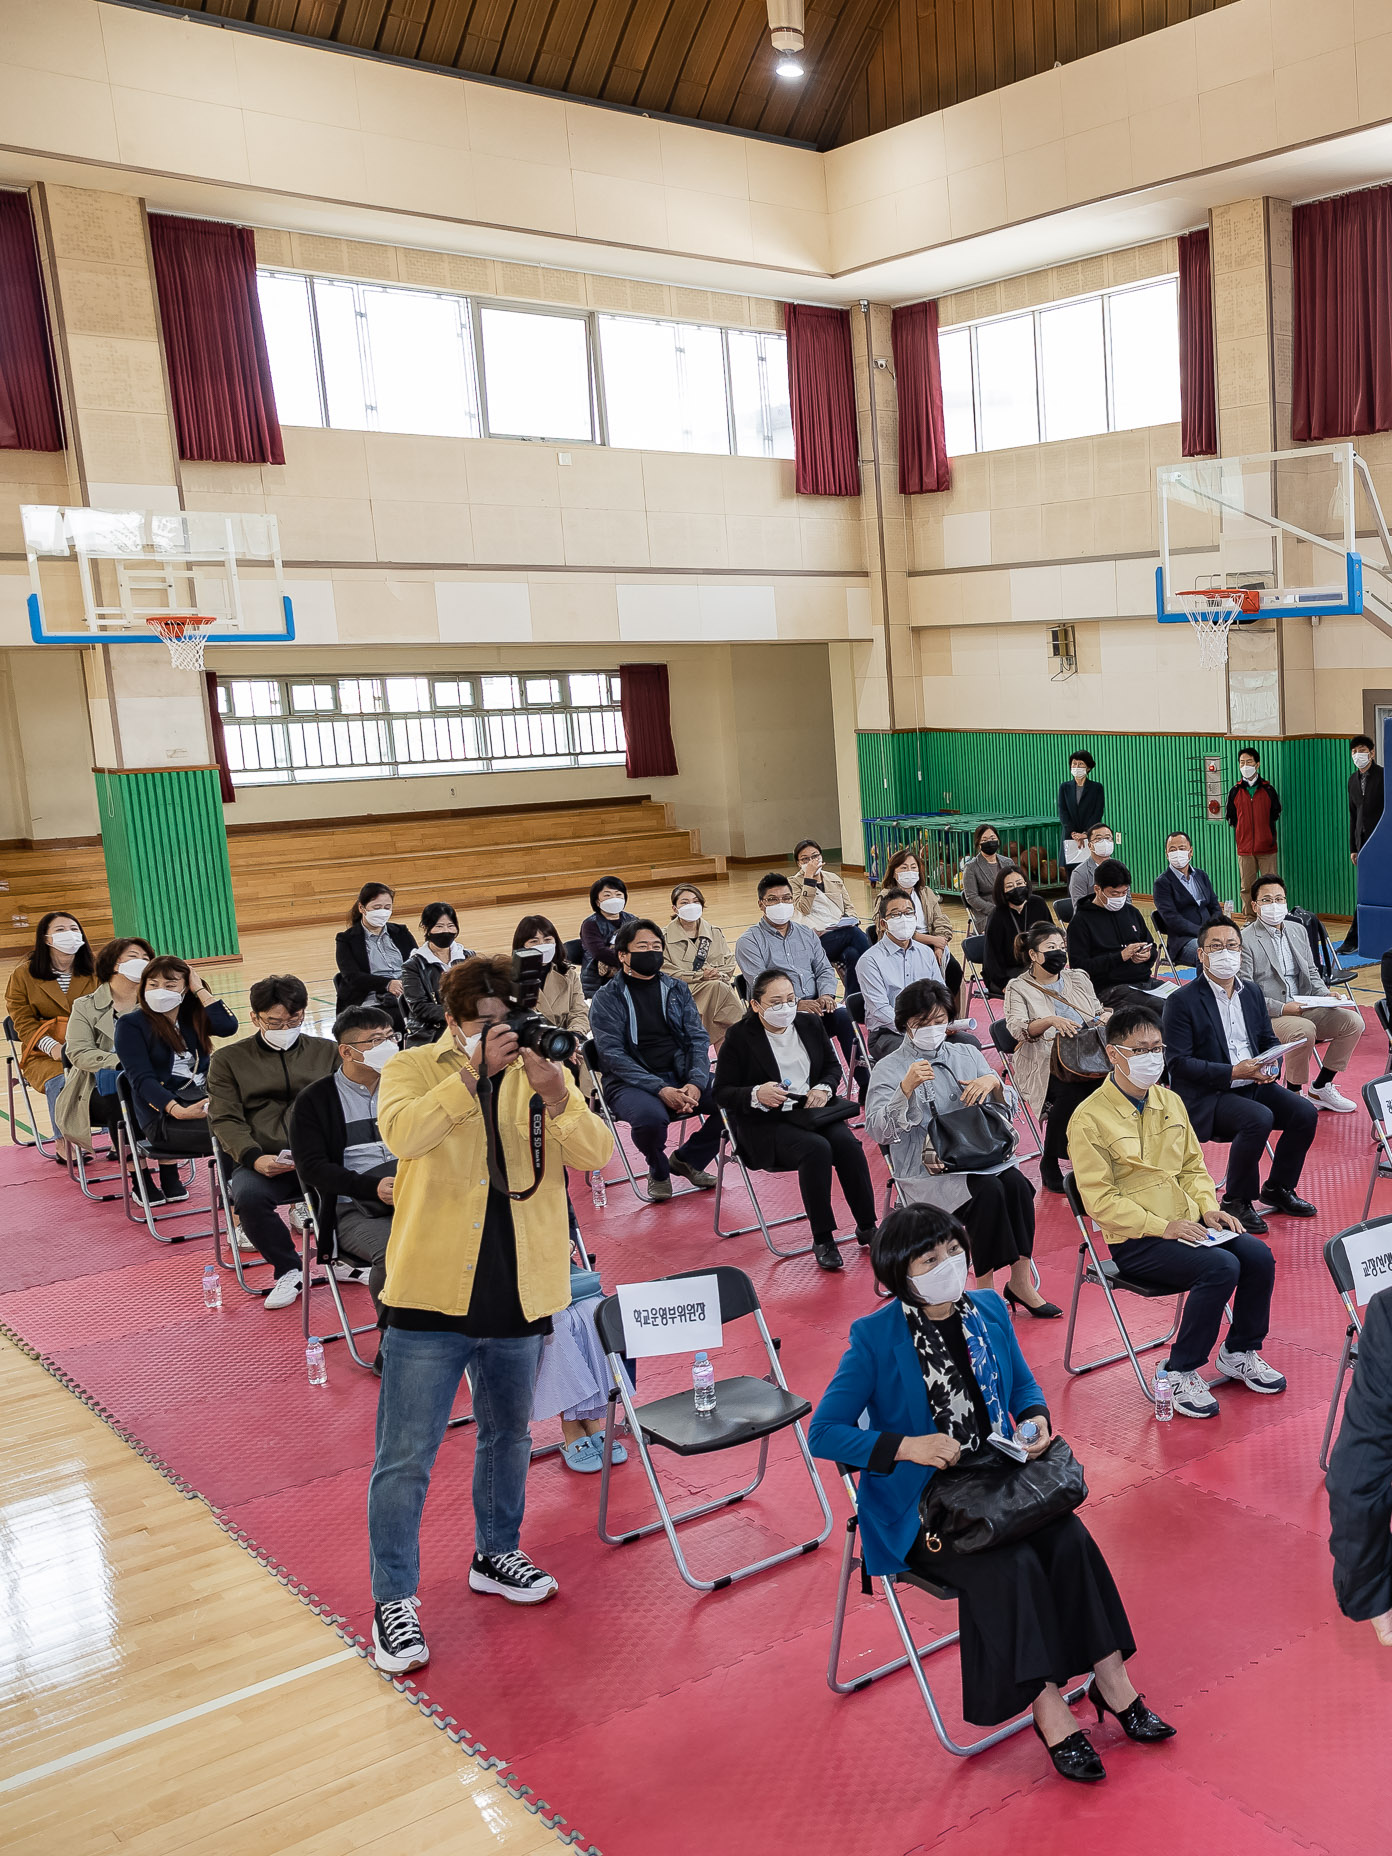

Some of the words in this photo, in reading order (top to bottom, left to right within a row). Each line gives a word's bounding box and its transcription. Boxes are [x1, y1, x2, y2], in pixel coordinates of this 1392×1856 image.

[533, 1113, 542, 1135] EOS
[534, 1137, 542, 1148] 5D
[633, 1302, 706, 1328] 학교운영부위원장
